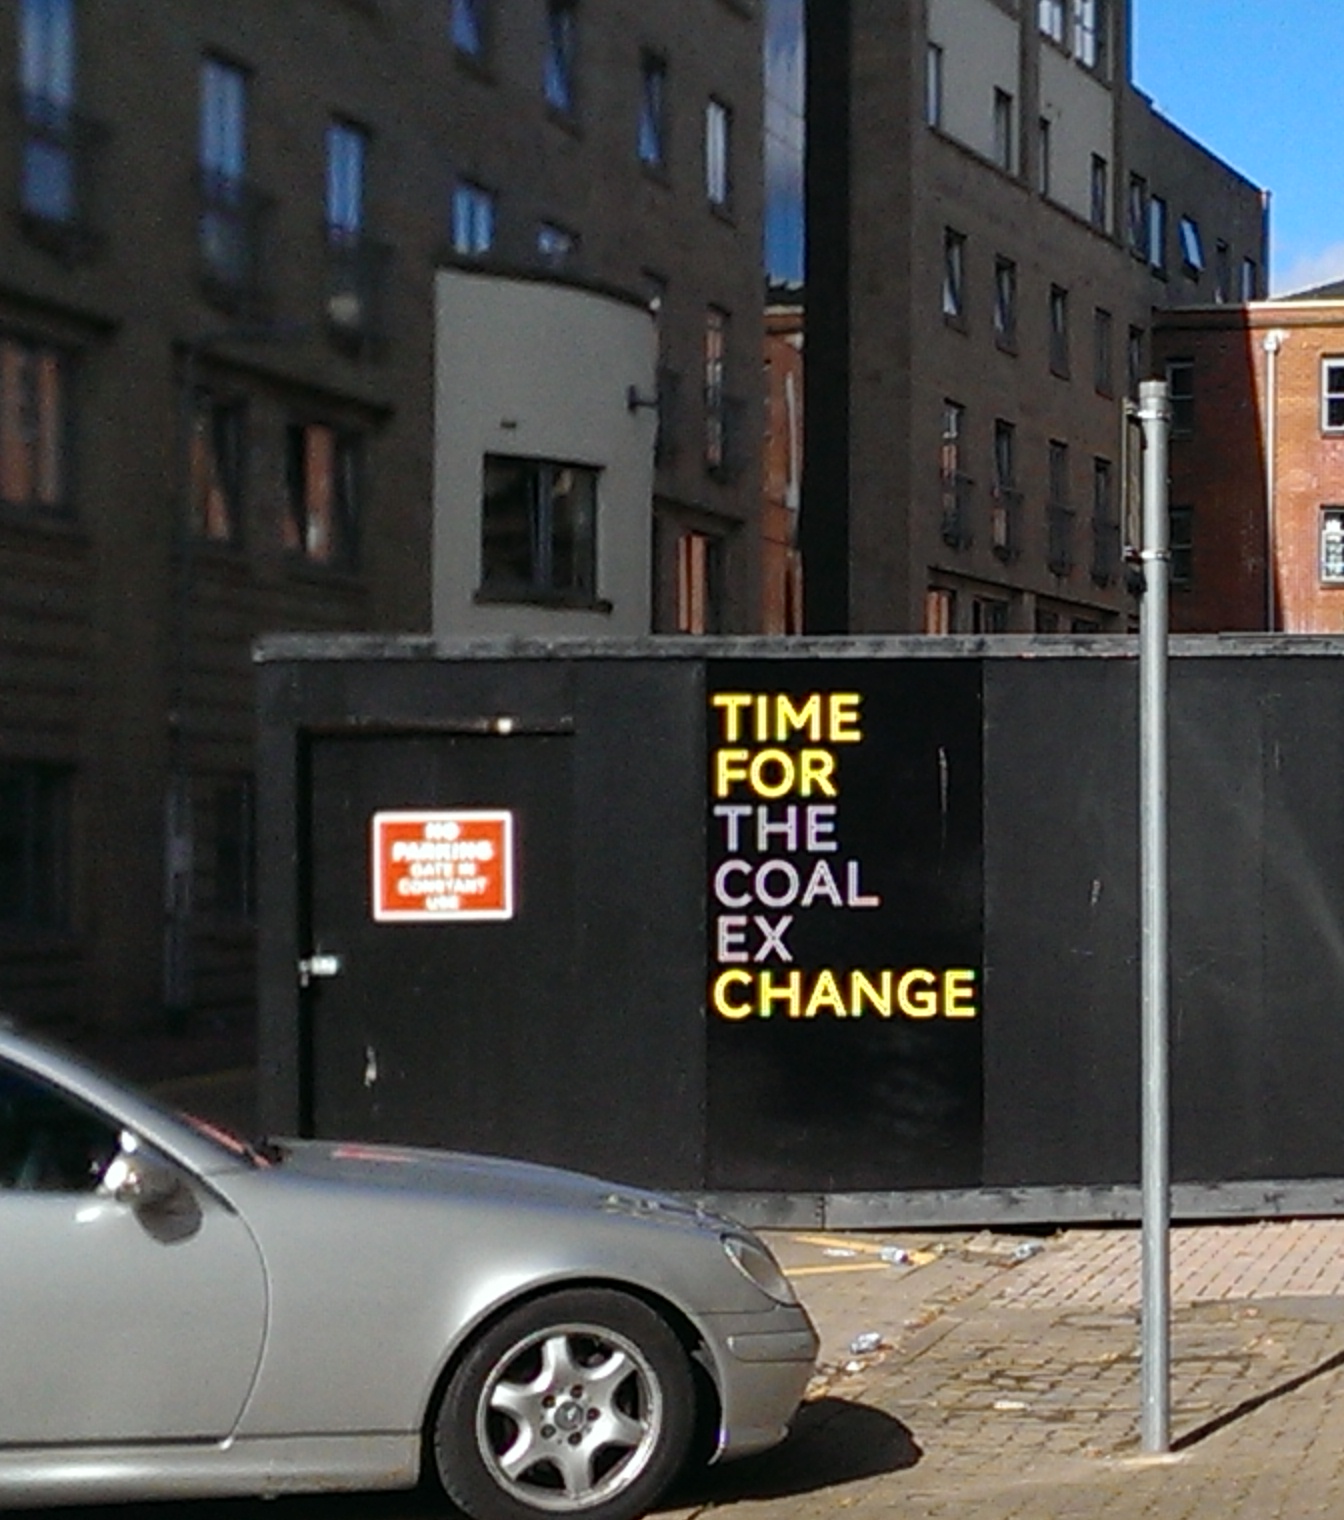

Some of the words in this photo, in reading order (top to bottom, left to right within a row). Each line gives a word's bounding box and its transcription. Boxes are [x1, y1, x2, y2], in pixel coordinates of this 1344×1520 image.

[712, 692, 862, 743] TIME
[715, 747, 838, 799] FOR
[391, 841, 495, 862] PARKING
[425, 821, 459, 839] NO
[712, 804, 840, 852] THE
[396, 876, 489, 896] CONSTANT
[409, 862, 454, 878] GATE
[713, 858, 881, 908] COAL
[715, 914, 794, 964] EX
[712, 967, 977, 1020] CHANGE
